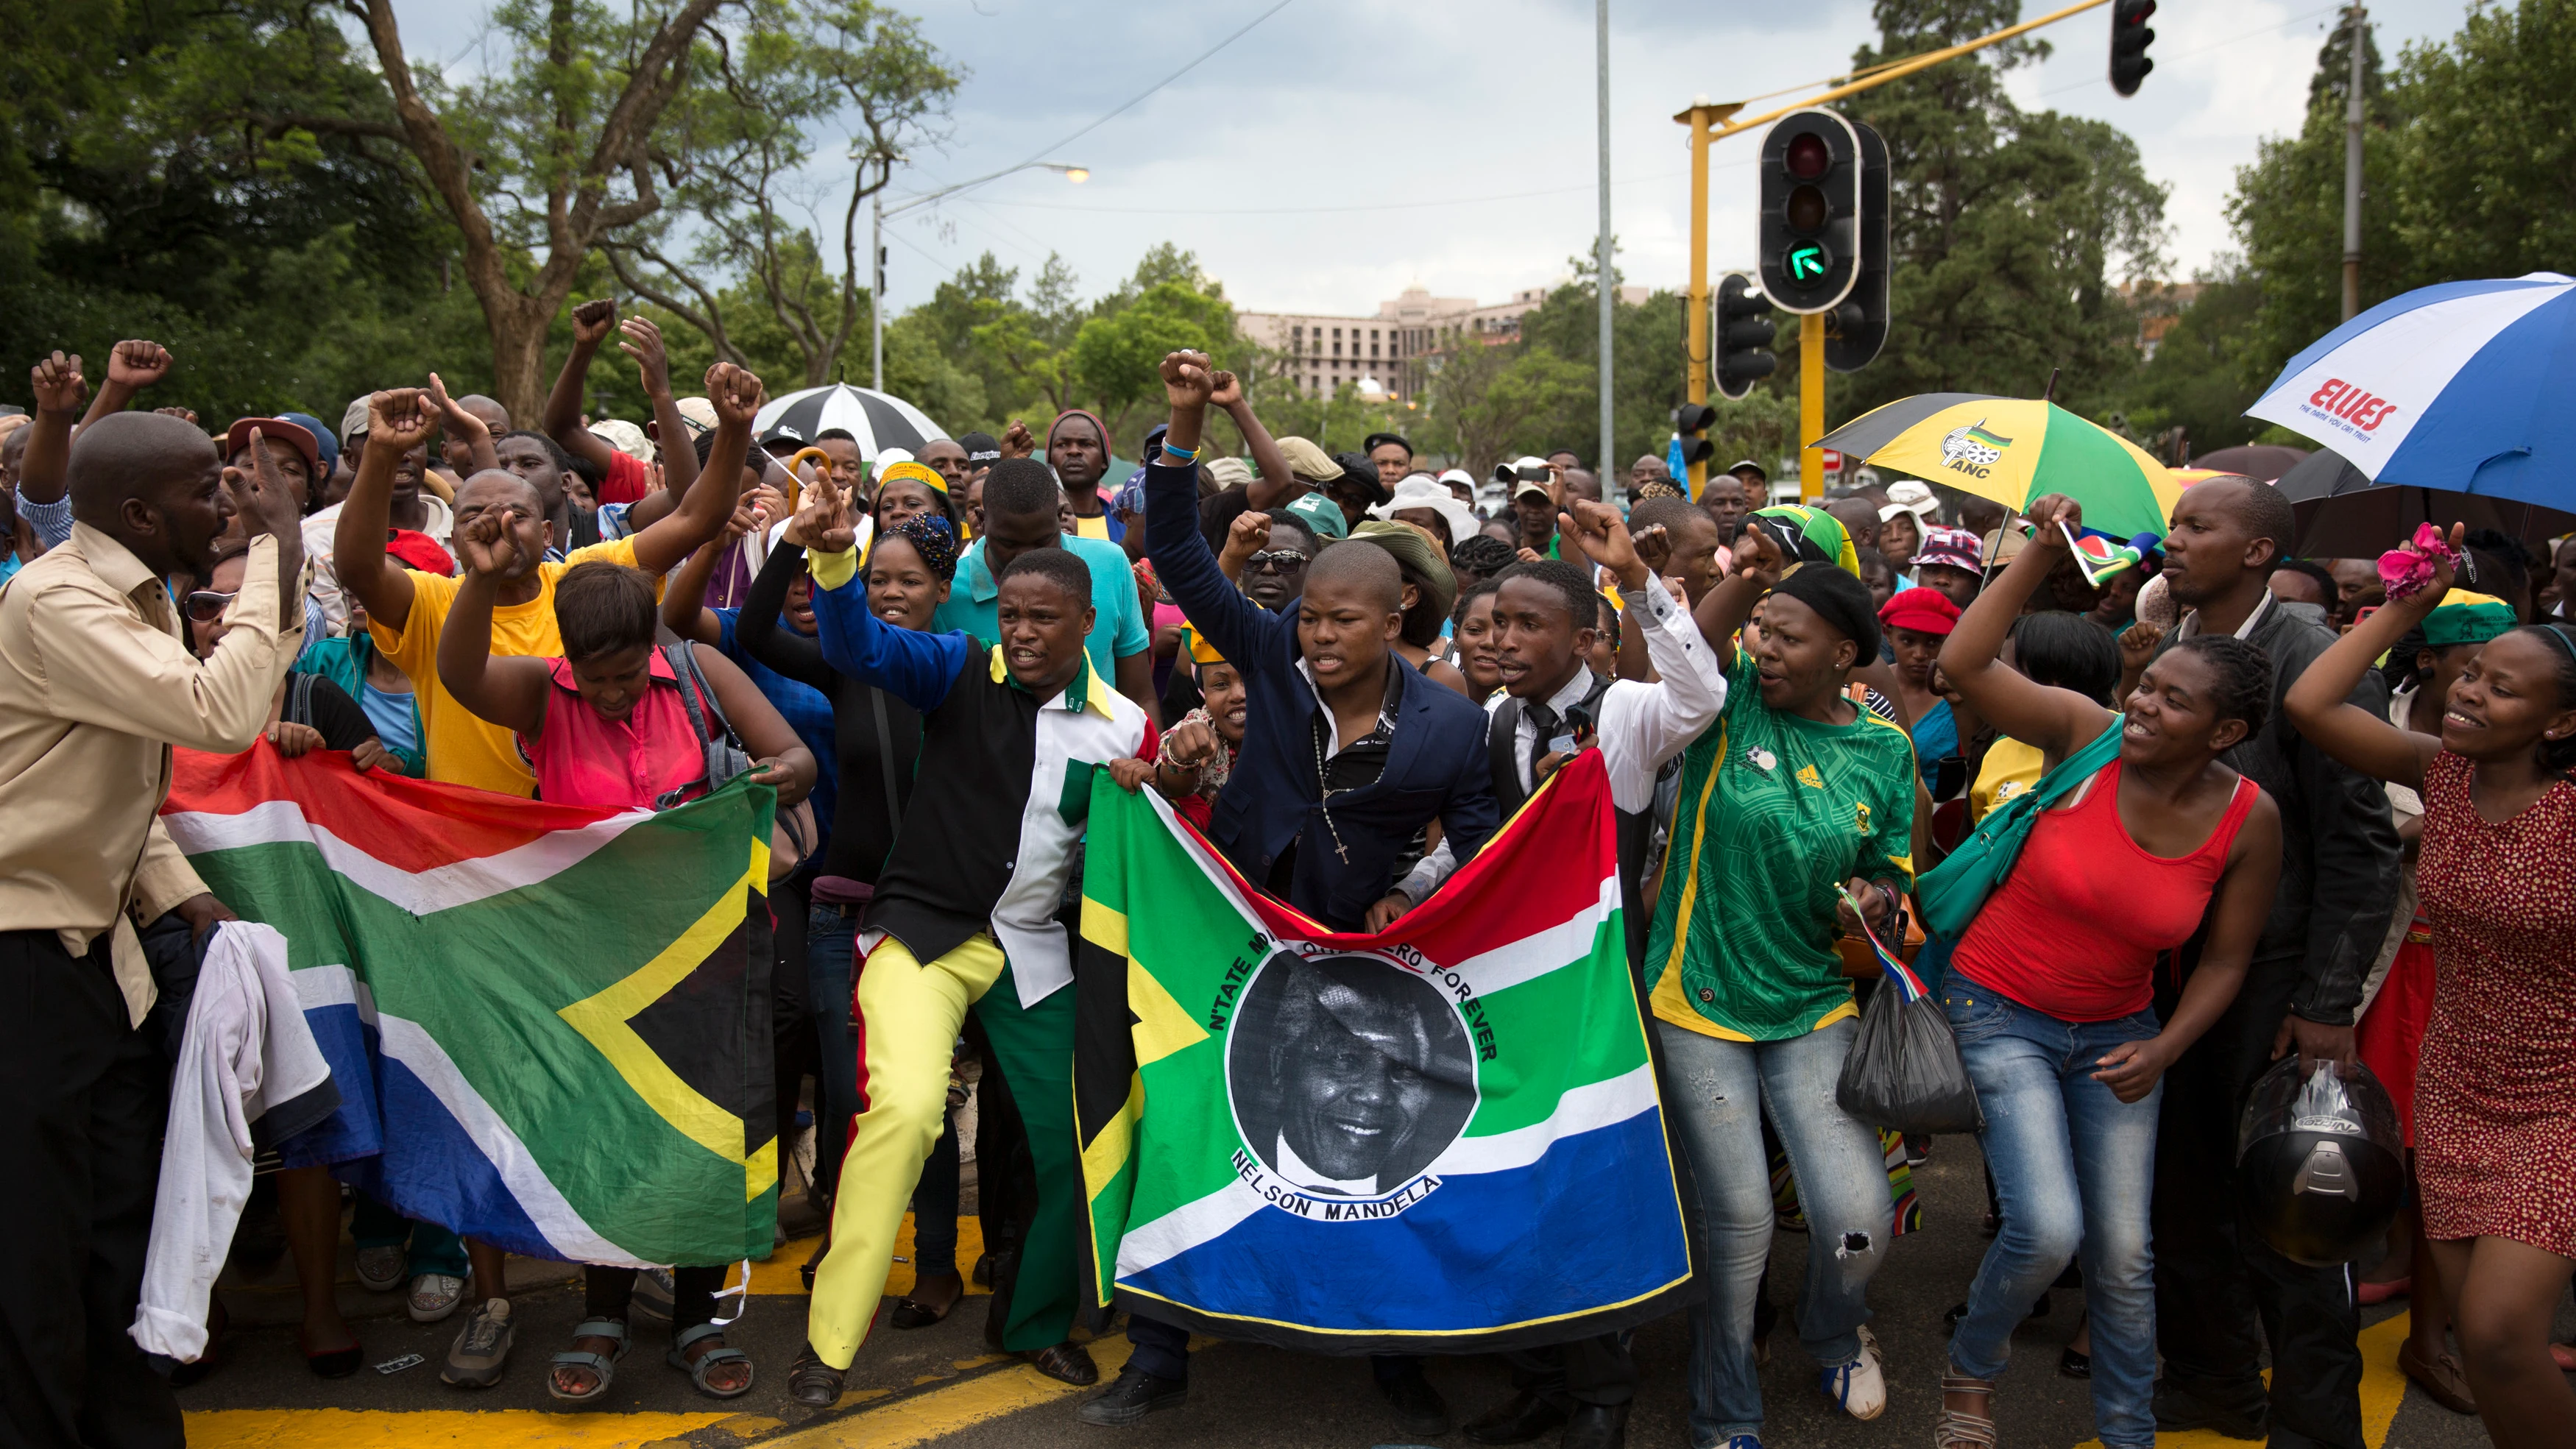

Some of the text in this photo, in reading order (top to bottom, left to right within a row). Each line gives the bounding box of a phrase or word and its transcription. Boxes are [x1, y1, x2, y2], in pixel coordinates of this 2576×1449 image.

[2299, 404, 2371, 444] THE NAME YOU CAN TRUST
[2310, 378, 2397, 431] ELLIES
[1949, 460, 1990, 479] ANC
[1209, 956, 1252, 1031] N'TATE
[1430, 964, 1498, 1063] FOREVER
[1232, 1149, 1440, 1220] NELSON MANDELA
